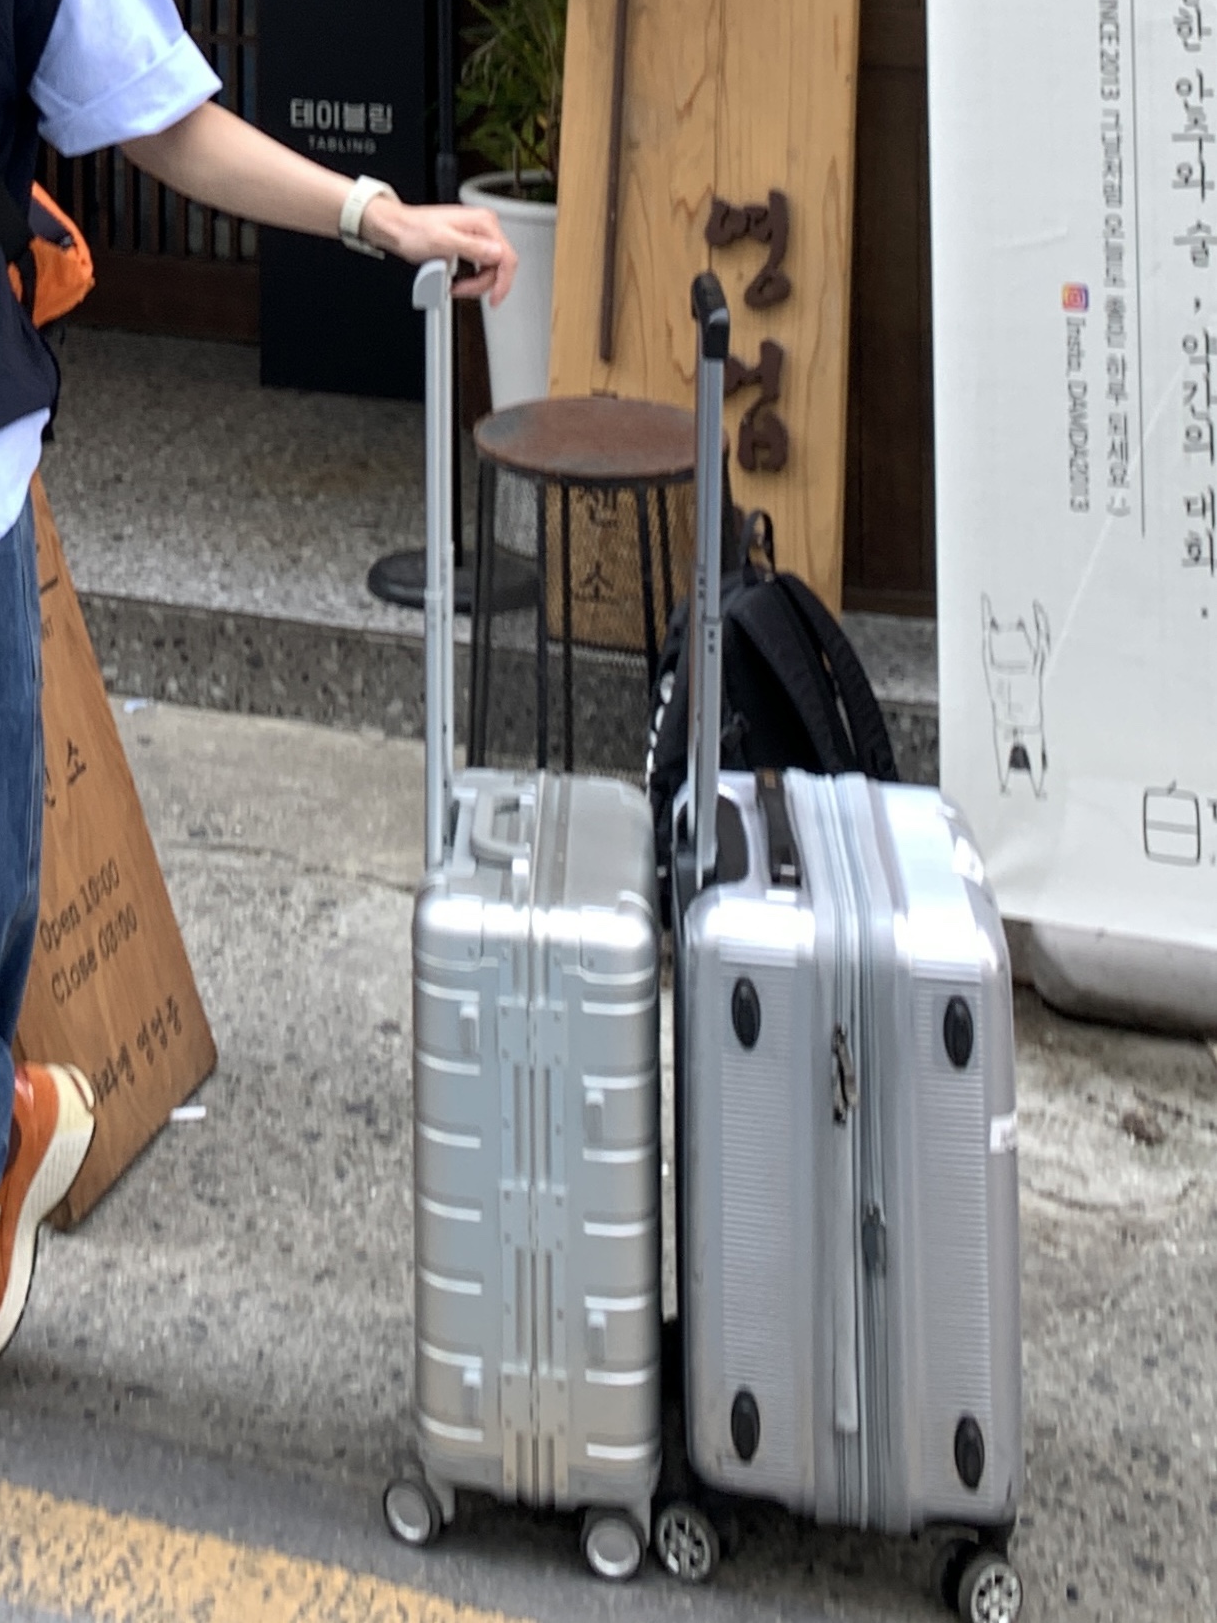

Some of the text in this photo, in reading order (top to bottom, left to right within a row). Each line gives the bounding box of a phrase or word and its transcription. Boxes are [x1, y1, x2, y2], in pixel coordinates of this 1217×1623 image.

[1099, 49, 1121, 101] 2013
[290, 97, 394, 134] 테이블링
[1171, 67, 1216, 203] 안주와
[307, 134, 378, 156] TABLING
[1105, 351, 1129, 407] 하루
[39, 857, 121, 954] Open 10:00
[51, 945, 99, 1008] Close
